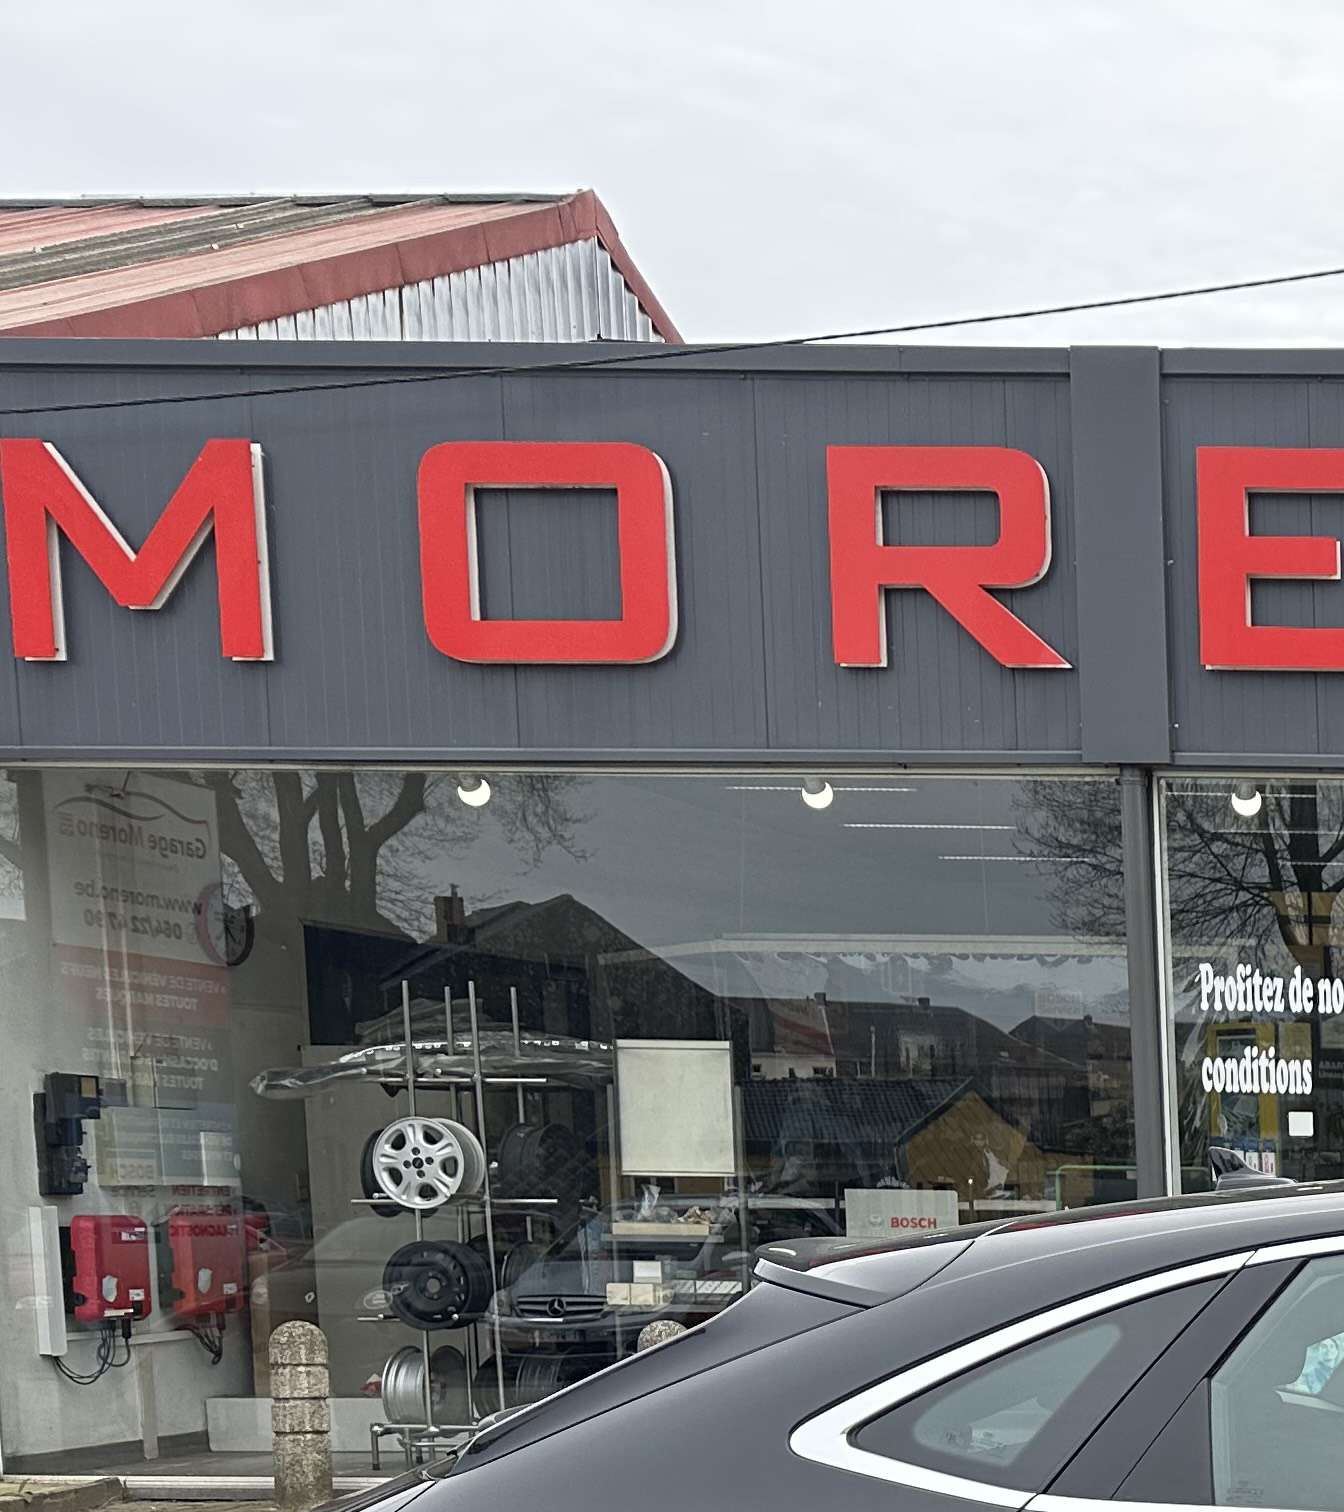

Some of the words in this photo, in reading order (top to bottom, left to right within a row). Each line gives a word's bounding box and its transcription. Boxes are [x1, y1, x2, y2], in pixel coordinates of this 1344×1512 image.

[1199, 962, 1286, 1014] Profitez
[1288, 966, 1315, 1014] de
[1202, 1046, 1313, 1095] conditions
[890, 1216, 938, 1229] BOSCH
